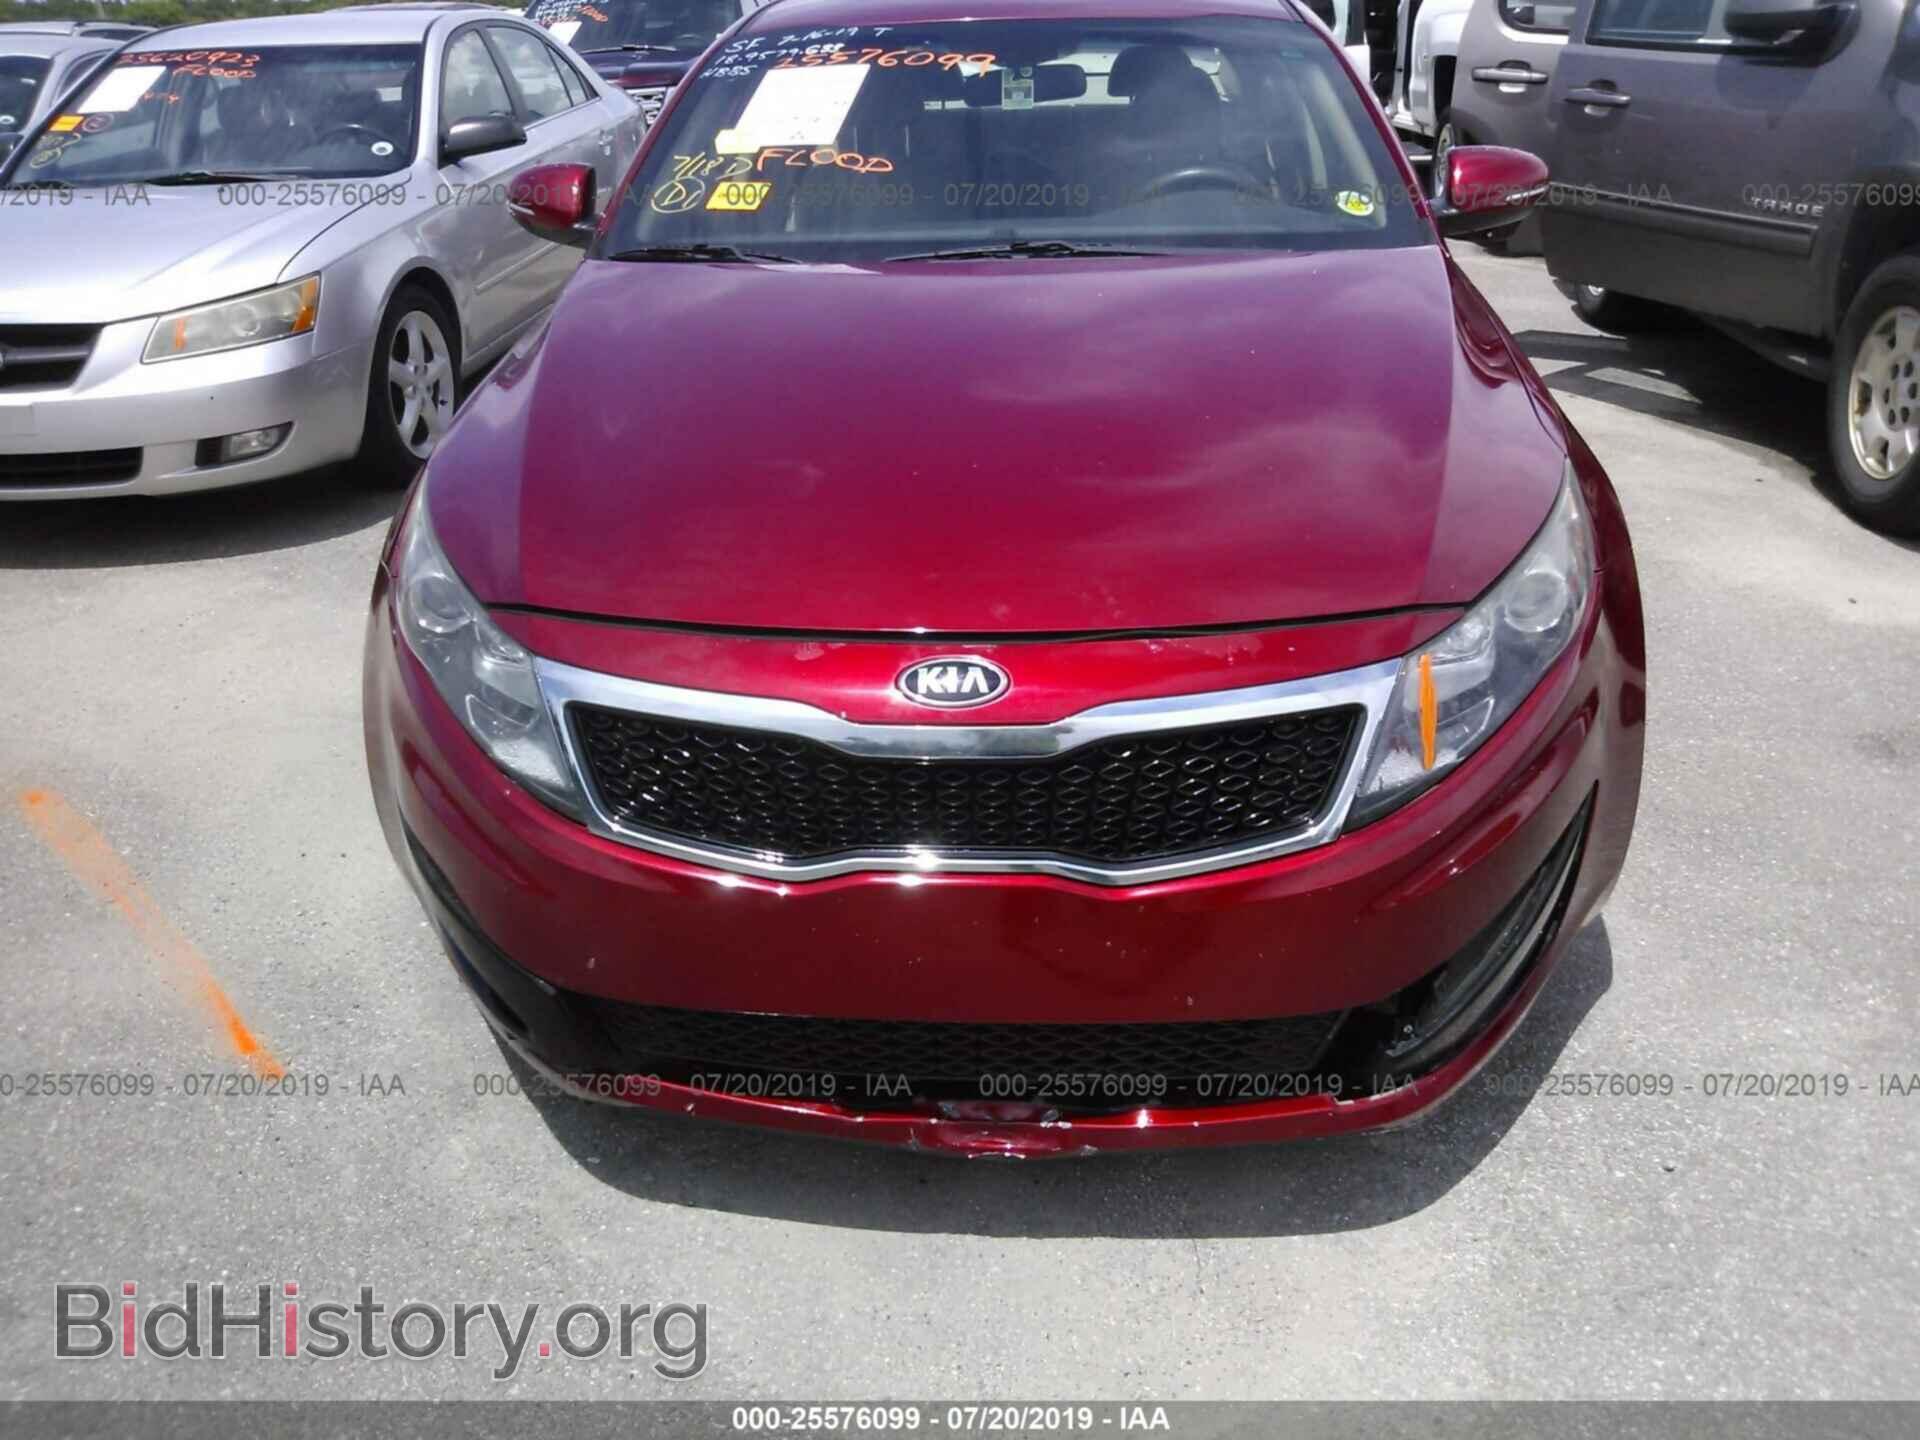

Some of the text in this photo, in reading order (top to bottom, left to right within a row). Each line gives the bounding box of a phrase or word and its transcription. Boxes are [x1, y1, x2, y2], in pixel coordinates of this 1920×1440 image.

[724, 36, 766, 53] SF
[872, 26, 895, 37] T
[770, 47, 996, 78] 25576099
[756, 148, 895, 174] FLOOD
[1751, 196, 1825, 217] TAHOE
[917, 666, 990, 694] KIA
